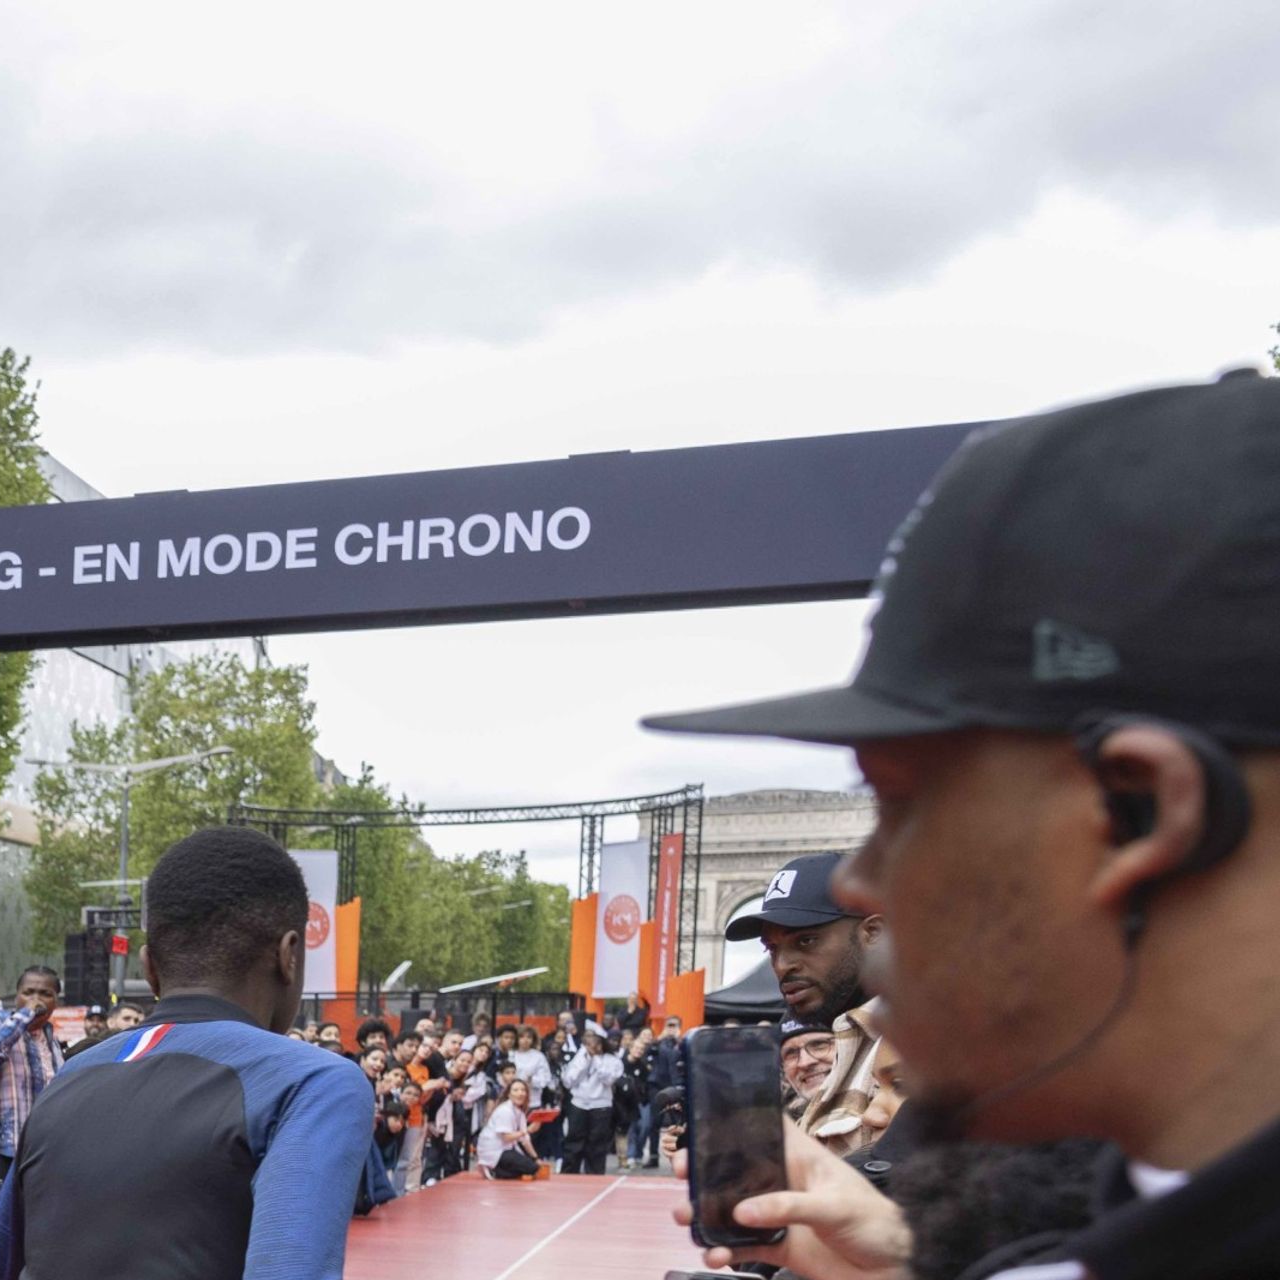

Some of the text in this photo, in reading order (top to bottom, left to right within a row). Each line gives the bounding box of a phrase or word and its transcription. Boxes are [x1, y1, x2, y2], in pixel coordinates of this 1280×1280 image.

[38, 566, 57, 577] -
[73, 541, 140, 585] EN
[158, 527, 319, 578] MODE
[334, 506, 591, 566] CHRONO
